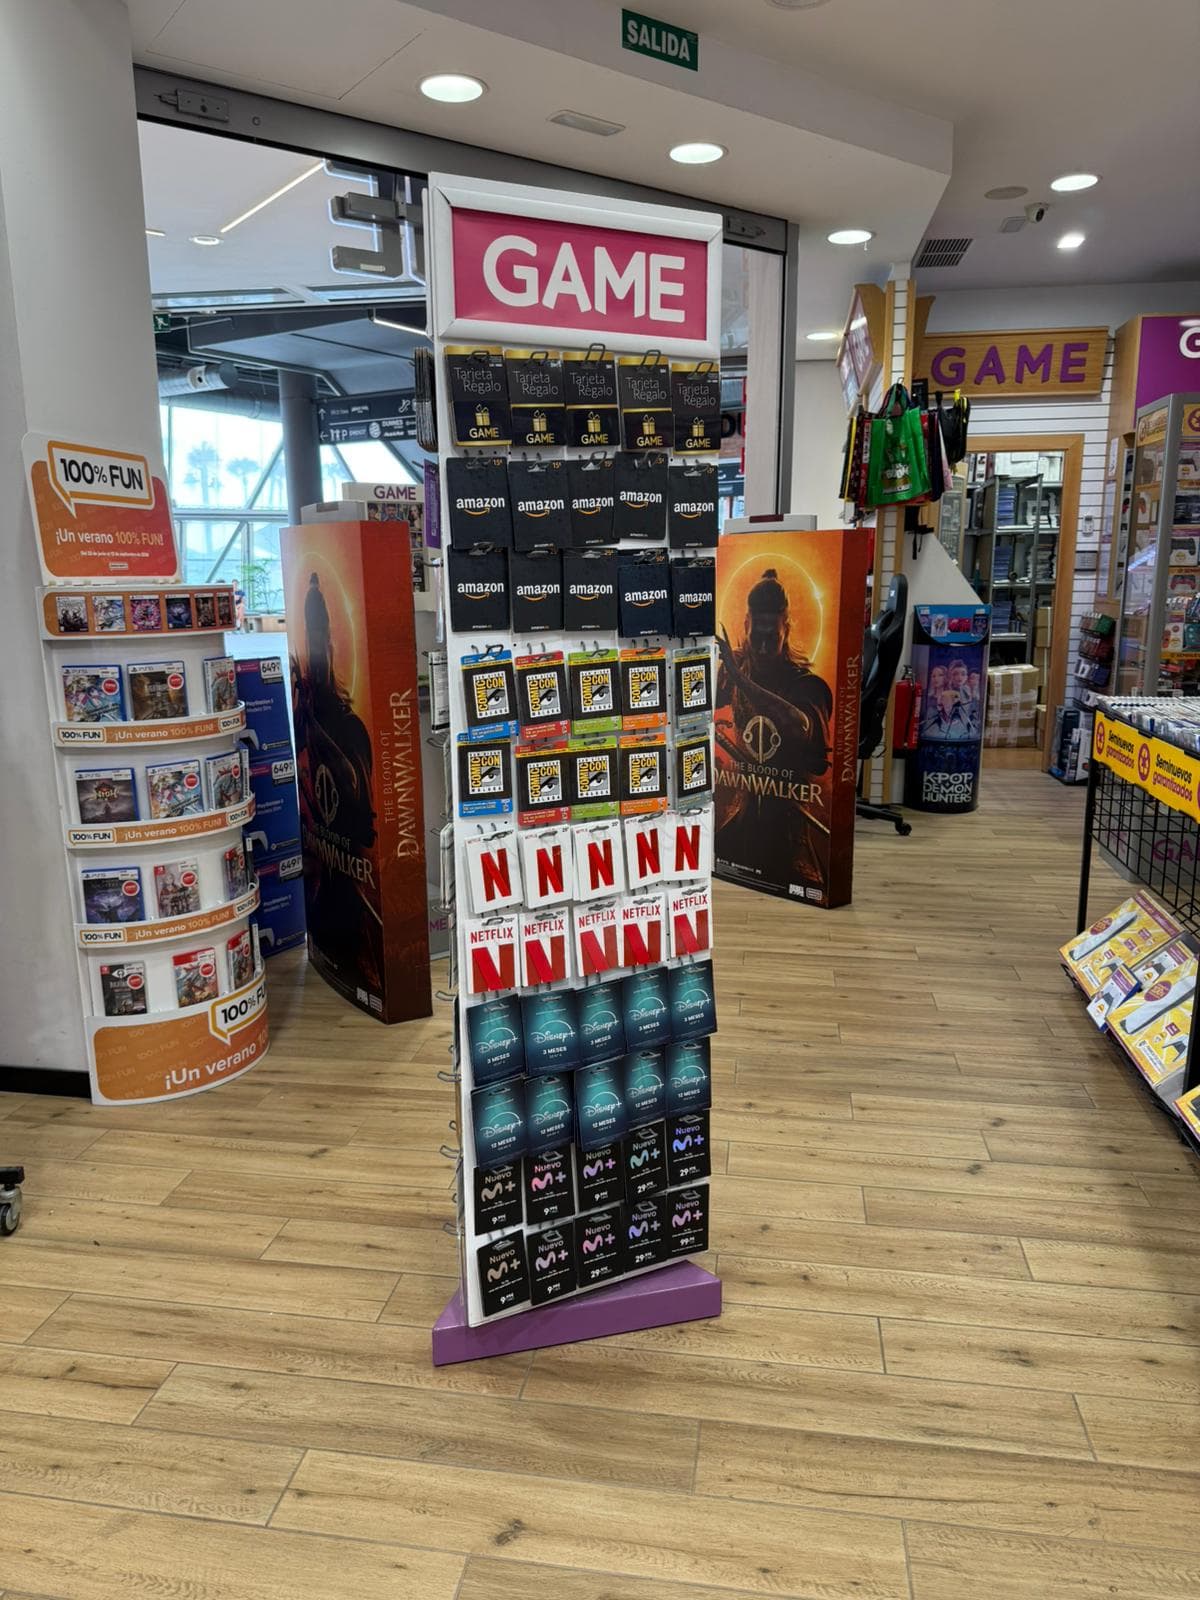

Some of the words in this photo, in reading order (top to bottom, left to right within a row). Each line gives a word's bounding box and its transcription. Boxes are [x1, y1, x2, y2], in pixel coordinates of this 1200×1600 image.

[627, 20, 690, 62] SALIDA
[483, 234, 686, 323] GAME
[931, 342, 1089, 387] GAME
[453, 367, 493, 383] Tarjeta
[513, 371, 550, 385] Tarjeta
[570, 372, 605, 387] Tarjeta
[463, 379, 502, 394] Regalo
[522, 382, 559, 397] Regalo
[578, 383, 613, 398] Regalo
[625, 377, 659, 392] Tarjeta
[677, 384, 710, 398] Tarjeta
[633, 387, 667, 402] Regalo
[683, 393, 716, 408] Regalo
[469, 427, 499, 439] GAME
[526, 433, 555, 444] GAME
[581, 433, 609, 444] GAME
[636, 435, 663, 447] GAME
[685, 437, 711, 449] GAME
[60, 458, 108, 484] 100%
[109, 465, 144, 491] FUN
[374, 485, 416, 500] GAME
[620, 491, 662, 503] amazon
[456, 497, 505, 509] amazon
[518, 500, 564, 512] amazon
[572, 496, 614, 510] amazon
[674, 502, 714, 513] amazon
[77, 531, 113, 544] verano
[115, 532, 141, 545] 100%
[457, 582, 504, 593] amazon
[517, 584, 560, 595] amazon
[569, 583, 613, 594] amazon
[625, 590, 667, 601] amazon
[679, 593, 712, 602] amazon
[592, 674, 609, 685] CON
[640, 671, 657, 681] CON
[690, 670, 704, 680] CON
[486, 677, 505, 688] CON
[539, 678, 556, 688] CON
[631, 672, 641, 703] COMIC
[476, 680, 489, 711] COMIC
[529, 680, 541, 711] COMIC
[582, 676, 593, 707] COMIC
[840, 654, 861, 783] DAWNWALKER
[61, 731, 81, 739] 100%
[83, 731, 100, 739] FUN
[135, 729, 168, 738] verano
[170, 726, 193, 736] 100%
[1109, 730, 1134, 754] Seminuevos
[481, 755, 500, 766] CON
[589, 760, 607, 772] CON
[640, 756, 657, 768] CON
[390, 688, 419, 858] DAWNWALKER
[471, 756, 481, 788] COMIC
[540, 766, 559, 777] CON
[631, 758, 641, 788] COMIC
[730, 760, 745, 771] THE
[747, 763, 779, 777] BLOOD
[782, 769, 794, 780] OF
[1155, 754, 1192, 784] Seminuevos
[530, 767, 541, 798] COMIC
[580, 762, 590, 792] COMIC
[923, 782, 973, 793] DEMON
[1153, 771, 1192, 802] garantizados
[922, 791, 972, 803] HUNTERS
[72, 833, 92, 841] 100%
[93, 832, 111, 840] FUN
[144, 828, 177, 838] verano
[179, 823, 202, 833] 100%
[636, 828, 661, 878] N
[675, 824, 700, 872] N
[536, 845, 564, 898] N
[587, 839, 615, 891] N
[480, 848, 512, 902] N
[672, 894, 708, 912] NETFLIX
[578, 909, 616, 928] NETFLIX
[622, 905, 661, 920] NETFLIX
[154, 924, 186, 935] verano
[524, 920, 565, 936] NETFLIX
[84, 933, 103, 941] 100%
[470, 927, 514, 943] NETFLIX
[221, 995, 256, 1024] 100%
[688, 1012, 705, 1022] MESES
[643, 1020, 660, 1031] MESES
[595, 1034, 612, 1045] MESES
[547, 1046, 567, 1054] MESES
[492, 1053, 510, 1063] MESES
[165, 1068, 200, 1090] ¡Un
[205, 1043, 256, 1075] verano
[684, 1089, 700, 1098] MESES
[642, 1097, 658, 1107] MESES
[546, 1123, 565, 1133] MESES
[599, 1117, 616, 1127] MESES
[675, 1125, 700, 1136] Nuevo
[498, 1136, 516, 1147] MESES
[632, 1138, 656, 1150] Nuevo
[586, 1148, 611, 1161] Nuevo
[534, 1161, 561, 1173] Nuevo
[485, 1171, 512, 1184] Nuevo
[675, 1200, 700, 1211] Nuevo
[632, 1211, 657, 1222] Nuevo
[585, 1223, 611, 1236] Nuevo
[538, 1240, 564, 1253] Nuevo
[489, 1249, 515, 1264] Nuevo
